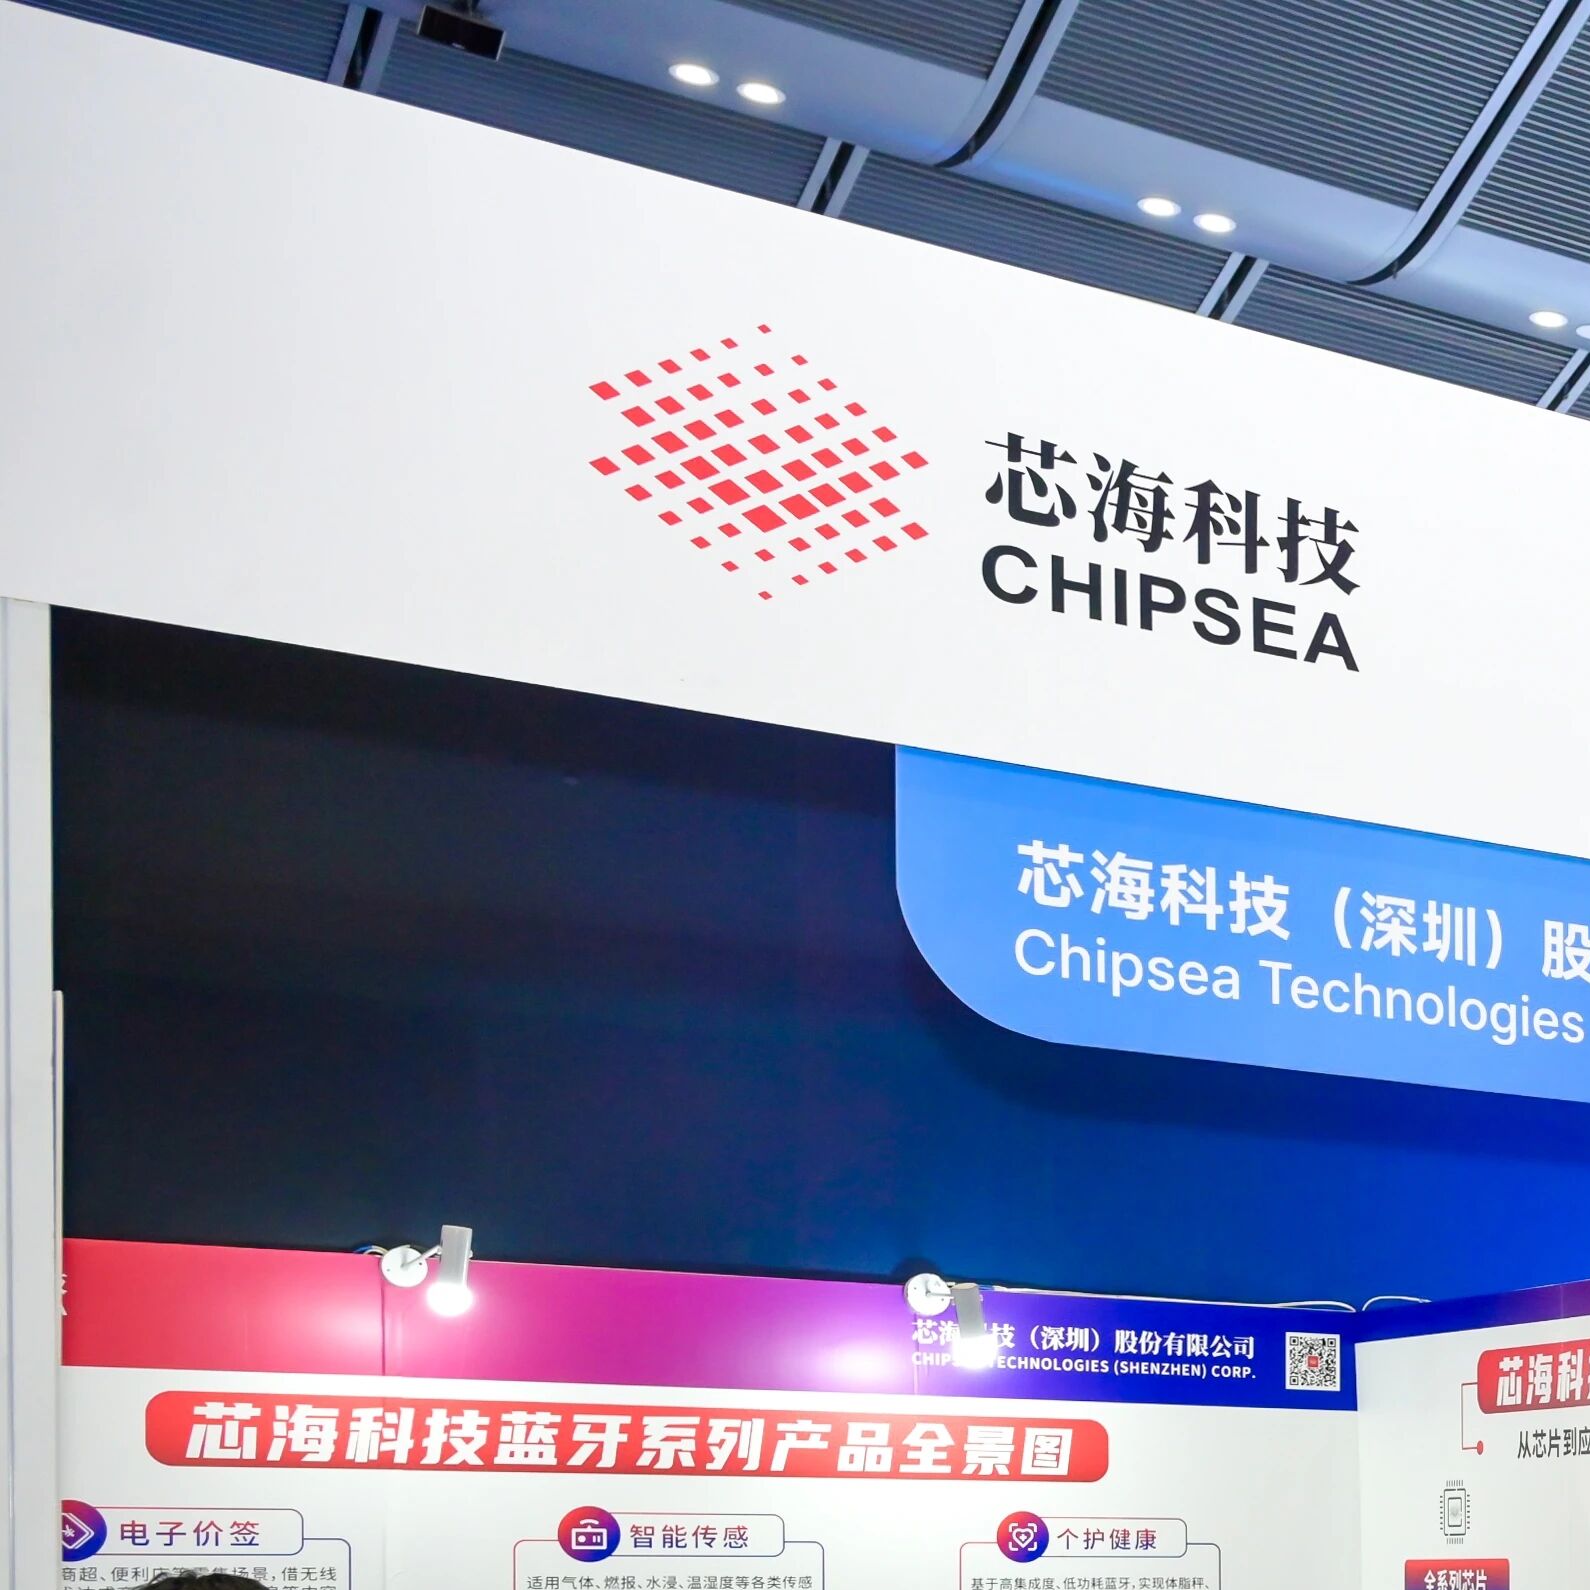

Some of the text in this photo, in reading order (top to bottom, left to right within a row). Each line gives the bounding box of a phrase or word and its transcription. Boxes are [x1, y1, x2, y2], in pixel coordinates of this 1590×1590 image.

[984, 432, 1360, 595] 芯海科技
[980, 545, 1360, 672] CHIPSEA
[1014, 930, 1243, 1002] Chipsea
[1258, 957, 1585, 1046] Technologies
[911, 1319, 1256, 1360] 芯海技（深圳）股份有限公司
[1113, 1361, 1207, 1379] (SHENZHEN)
[1211, 1364, 1257, 1379] CORP.
[185, 1401, 1074, 1477] 芯海科技蓝牙系列产品全景图
[119, 1519, 261, 1548] 电子价签
[629, 1524, 749, 1550] 智能传感
[1057, 1528, 1158, 1551] 个护健康
